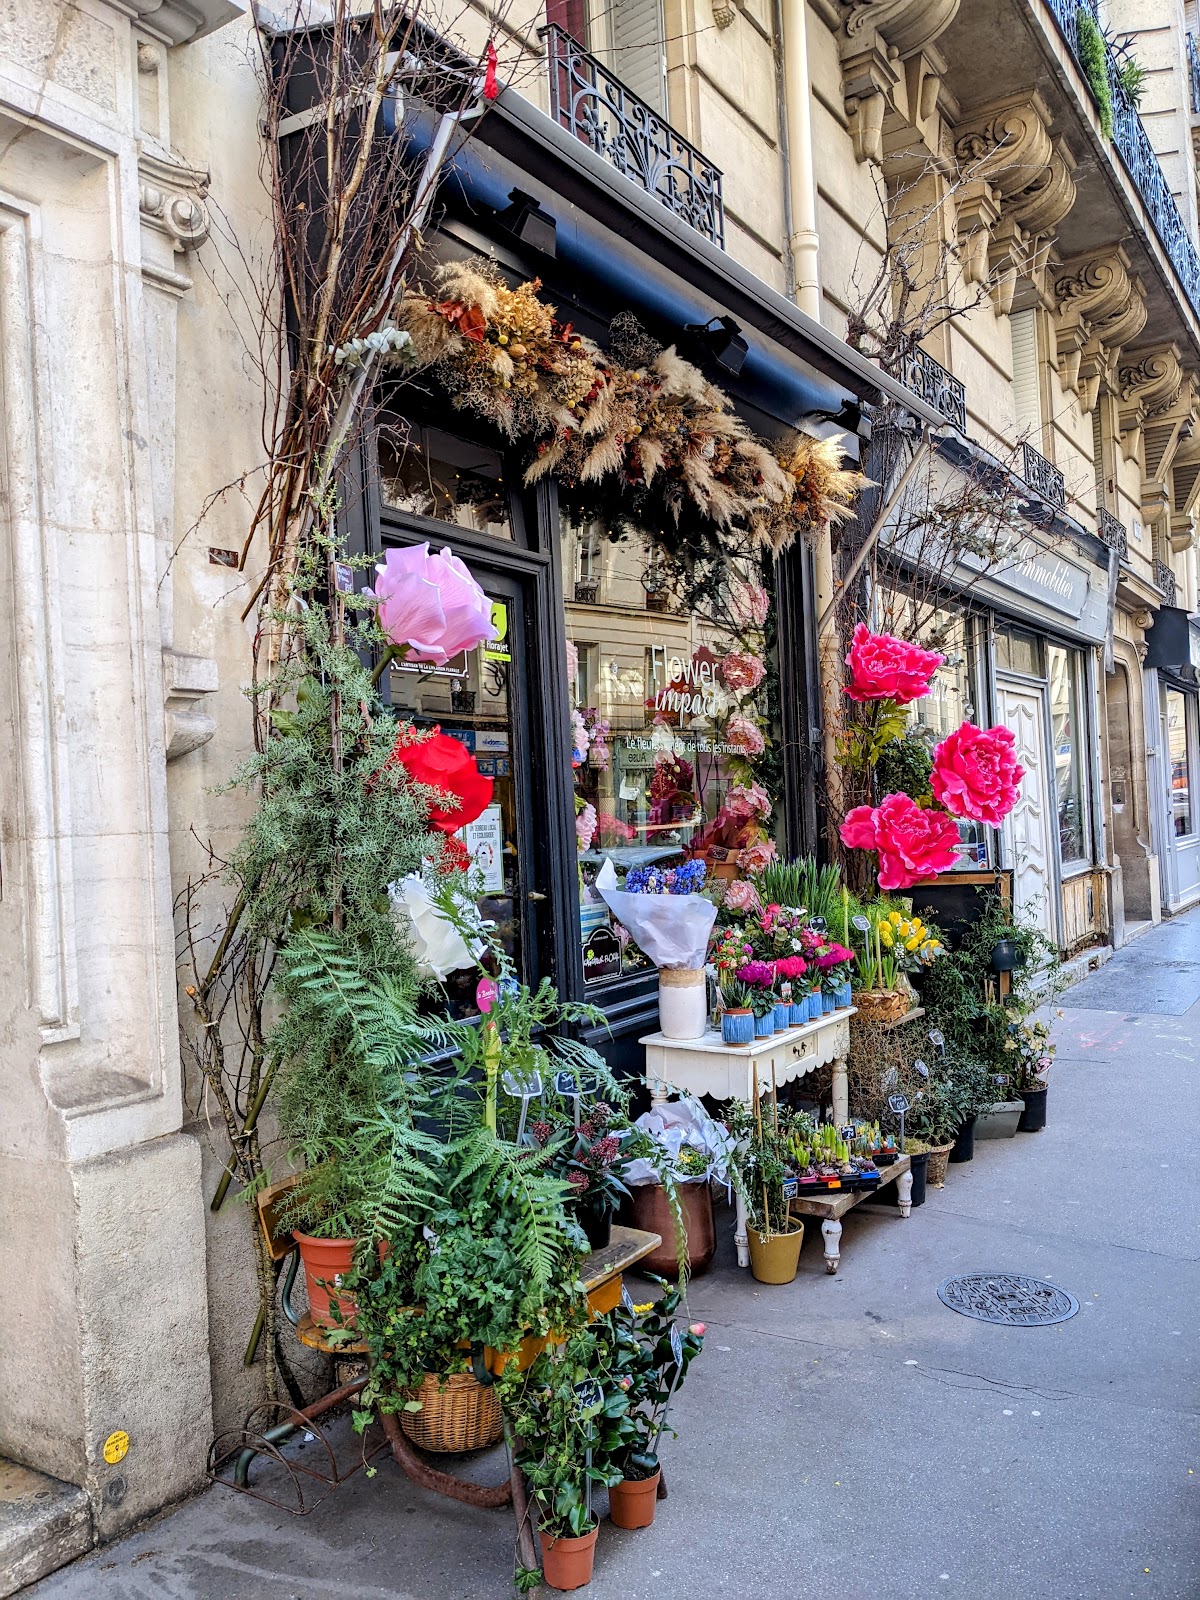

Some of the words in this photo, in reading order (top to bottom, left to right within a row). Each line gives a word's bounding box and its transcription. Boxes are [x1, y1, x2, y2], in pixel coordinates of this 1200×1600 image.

[1014, 541, 1074, 600] Immobilier
[651, 644, 719, 688] Flower
[654, 681, 720, 729] impact
[626, 736, 636, 750] Le
[687, 740, 697, 753] de
[697, 741, 712, 753] tous
[712, 741, 722, 754] les
[722, 742, 747, 755] instants
